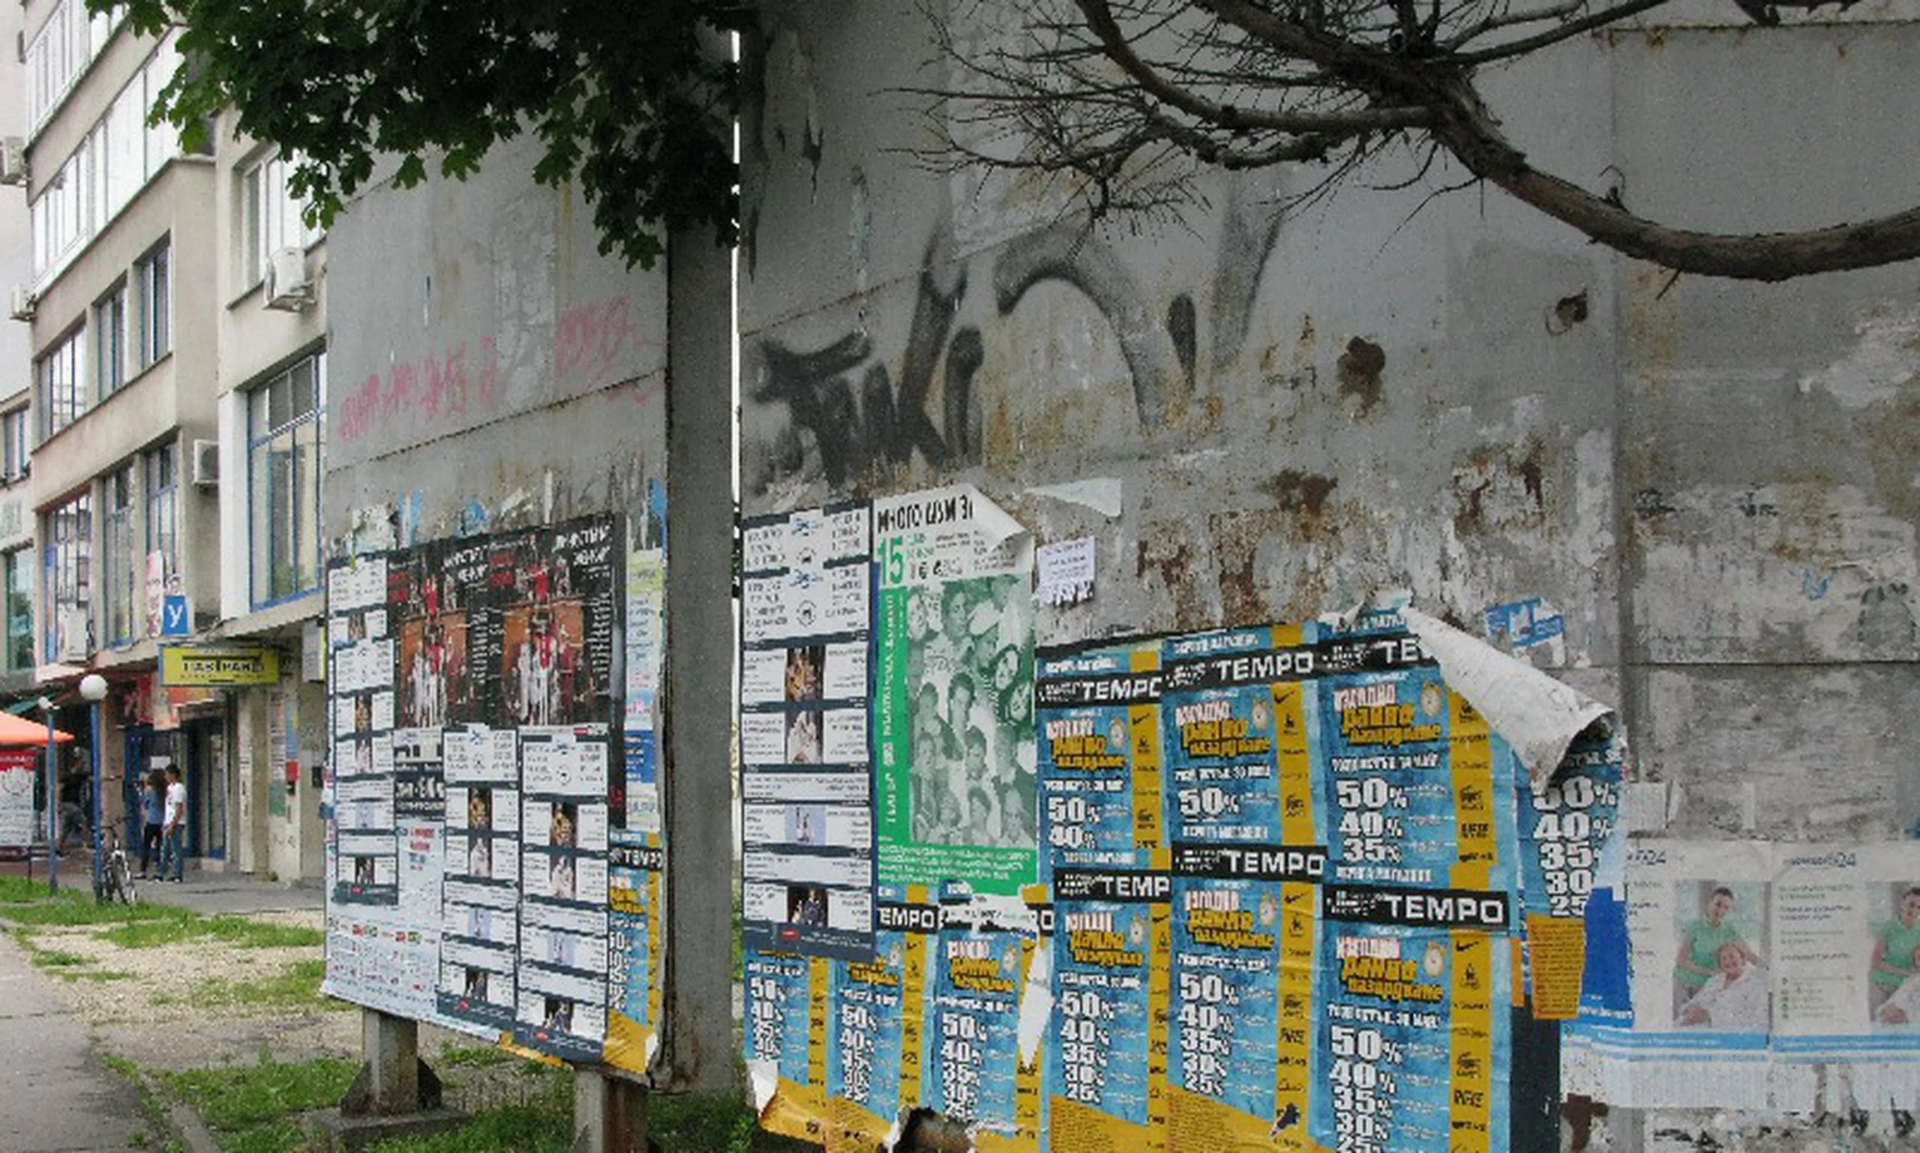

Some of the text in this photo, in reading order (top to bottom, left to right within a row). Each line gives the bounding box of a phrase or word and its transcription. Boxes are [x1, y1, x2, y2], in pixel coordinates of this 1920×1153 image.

[877, 536, 904, 586] 15
[1379, 638, 1421, 664] TE
[1216, 652, 1314, 681] TEMPO
[1083, 676, 1161, 700] TEMPO
[1179, 786, 1239, 816] 50%
[1336, 778, 1407, 808] 50%
[1047, 796, 1100, 824] 50%
[1339, 812, 1403, 837] 40%
[1533, 813, 1614, 840] 40%
[1228, 852, 1325, 875] TEMPO
[1103, 875, 1169, 897] TEMP
[877, 907, 935, 928] EMPO
[1384, 893, 1503, 923] TEMPO
[1180, 973, 1239, 1005] 50%
[1062, 991, 1115, 1019] 50%
[1178, 1004, 1234, 1033] 40%
[1331, 1026, 1402, 1064] 50%
[1329, 1059, 1397, 1094] 40%
[1334, 1087, 1393, 1118] 35%
[1336, 1112, 1388, 1140] 30%
